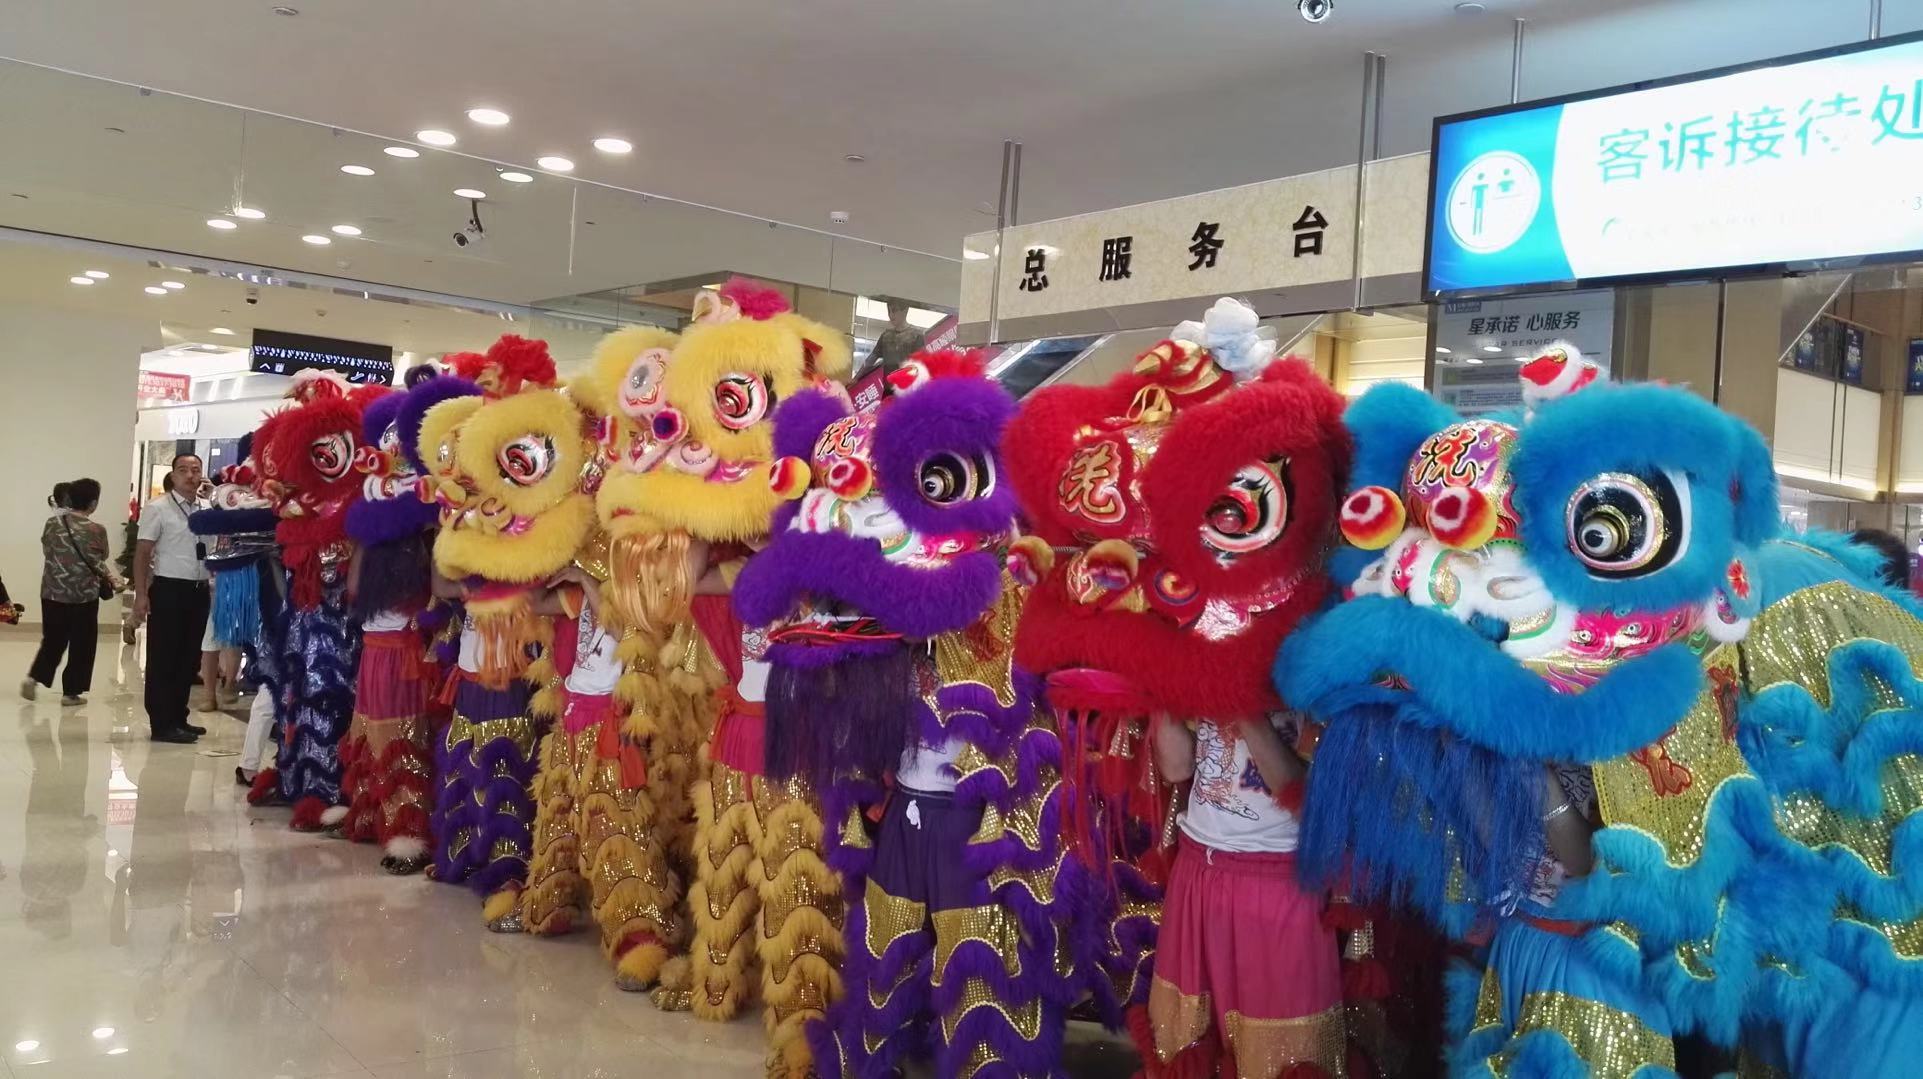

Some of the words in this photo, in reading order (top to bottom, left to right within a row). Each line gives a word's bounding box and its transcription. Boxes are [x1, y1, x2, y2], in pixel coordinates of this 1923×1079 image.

[1597, 78, 1923, 183] 客诉接待处
[1019, 205, 1328, 293] 总服务台
[1467, 315, 1520, 336] 星承诺
[1526, 311, 1581, 332] 心服务
